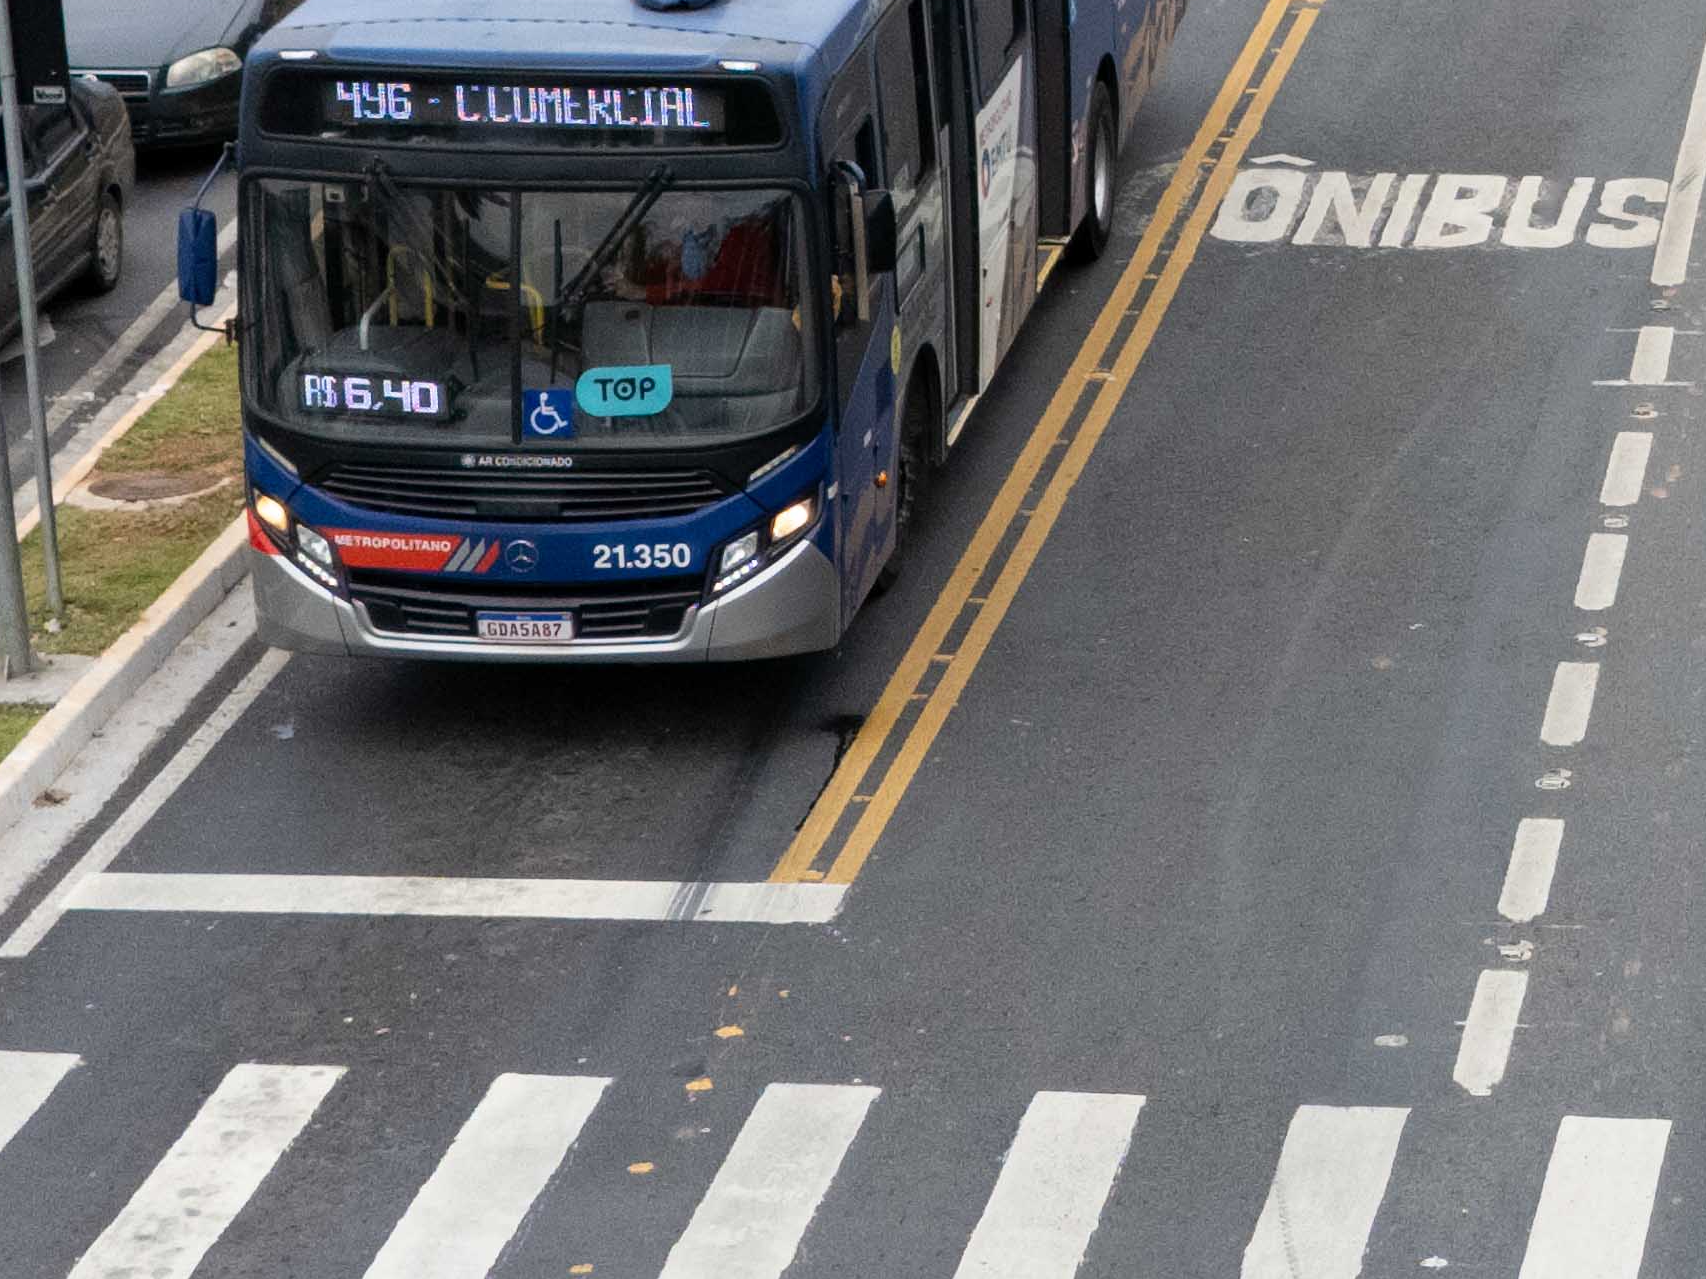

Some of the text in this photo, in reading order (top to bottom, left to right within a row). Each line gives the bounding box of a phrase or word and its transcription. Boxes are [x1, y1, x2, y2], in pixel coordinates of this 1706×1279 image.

[1209, 153, 1671, 249] ÔNIBUS
[304, 373, 440, 415] R$ 6,40
[478, 455, 494, 467] AR
[334, 534, 452, 553] METROPOLITANO
[592, 543, 692, 569] 21.350
[486, 622, 563, 638] GDA5A87
